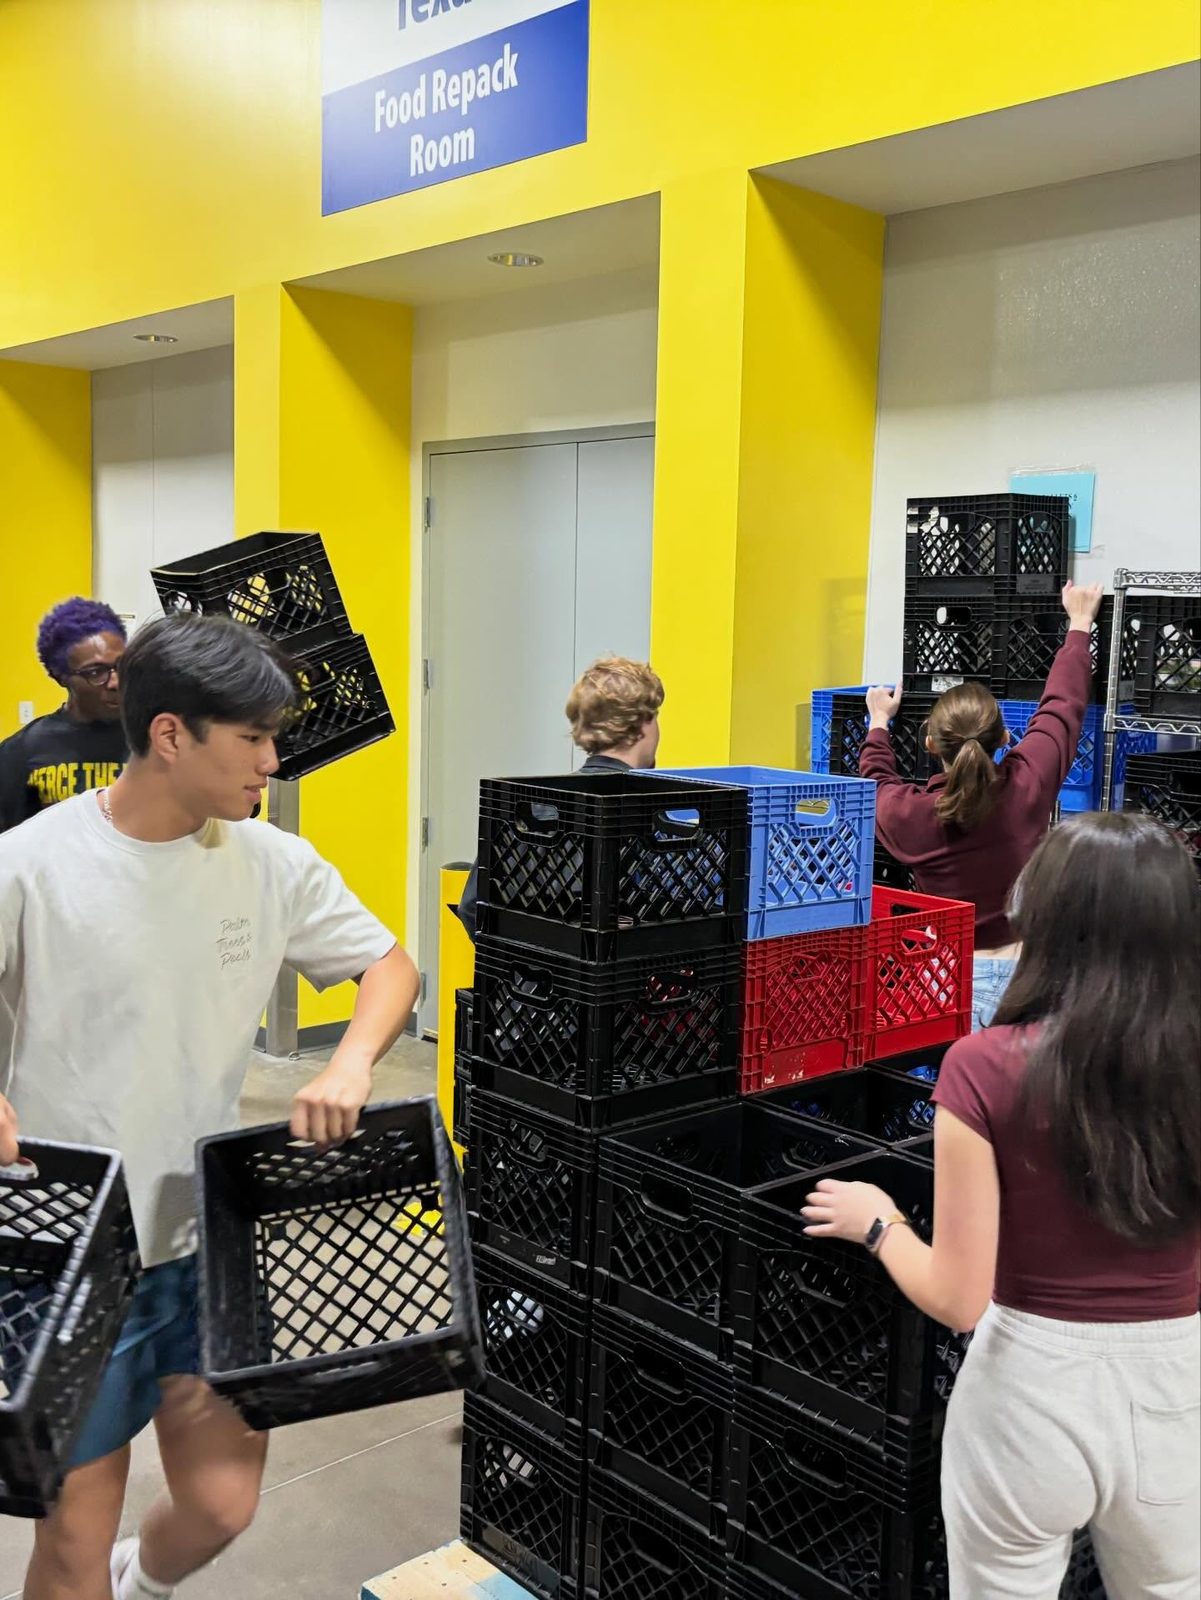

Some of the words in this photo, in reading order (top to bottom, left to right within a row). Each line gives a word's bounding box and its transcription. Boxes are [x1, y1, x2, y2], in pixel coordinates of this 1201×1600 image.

[374, 74, 427, 134] Food
[432, 43, 519, 116] Repack
[410, 127, 475, 177] Room
[83, 762, 119, 791] THE
